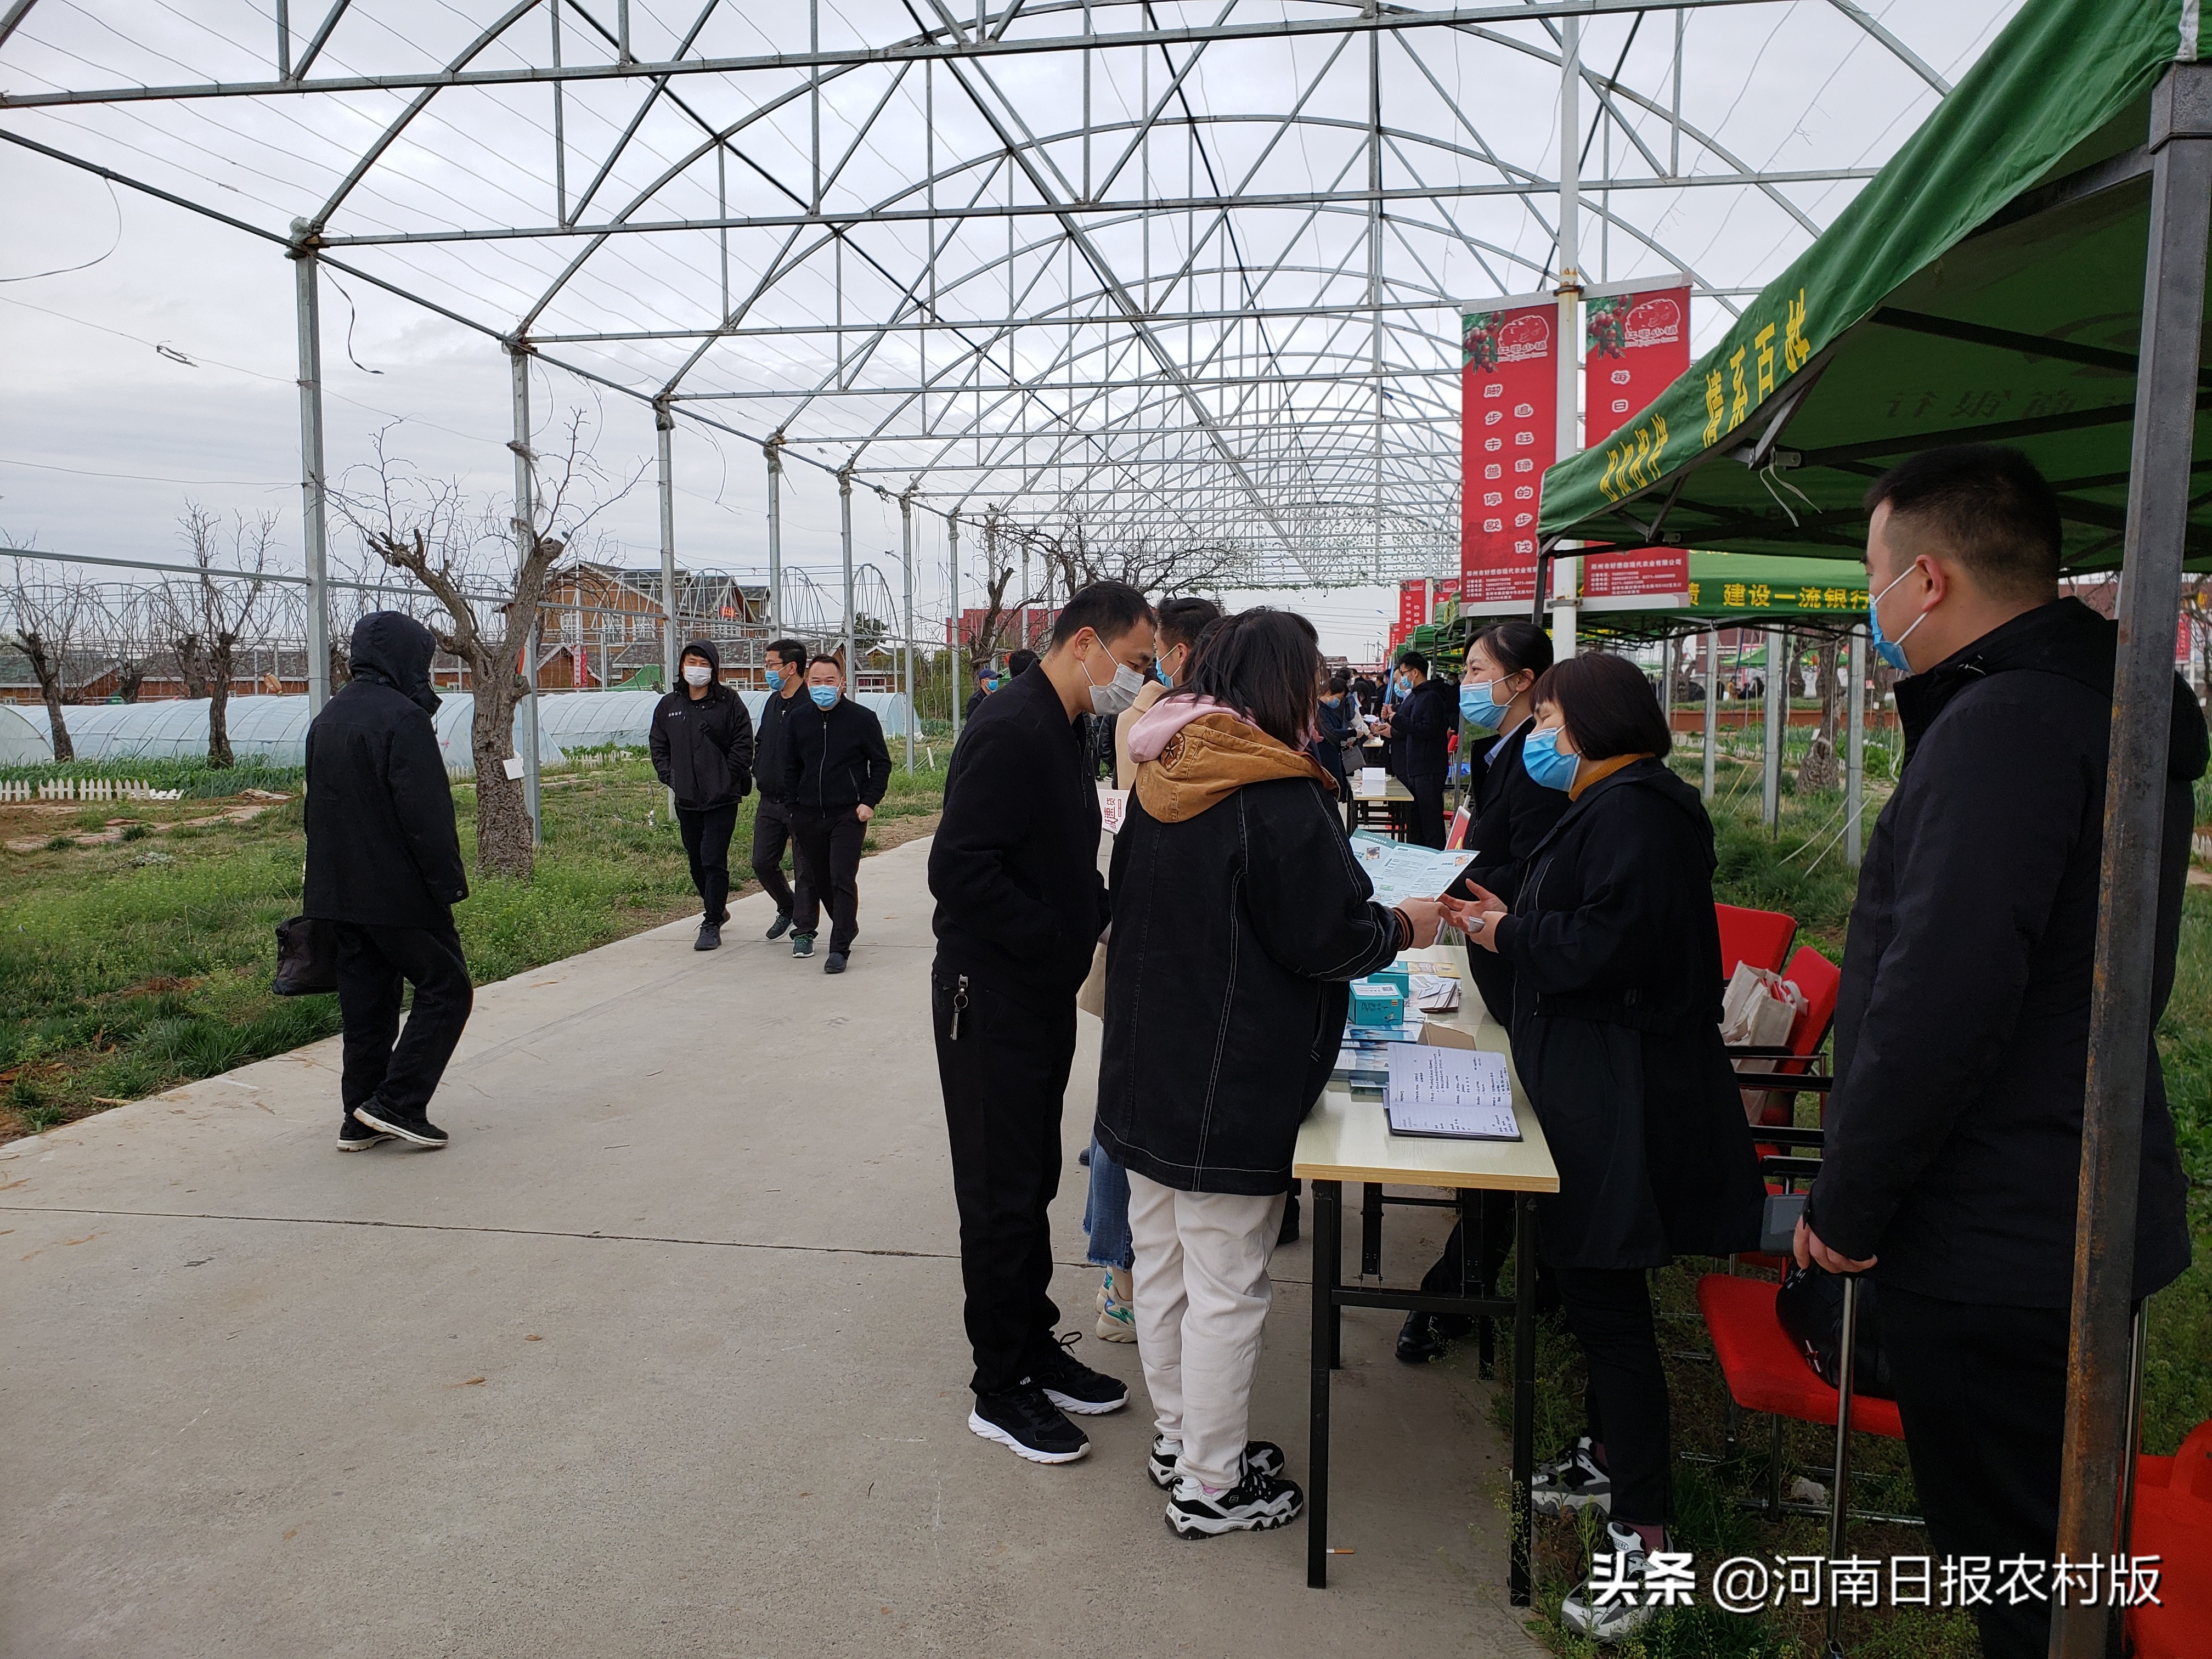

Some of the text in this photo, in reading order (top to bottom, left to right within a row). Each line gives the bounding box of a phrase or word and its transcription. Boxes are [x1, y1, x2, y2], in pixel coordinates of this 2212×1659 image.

[1610, 369, 1631, 435] 每日
[1703, 287, 1811, 448] 情系百姓
[1483, 384, 1503, 532] 脚步未曾停歇
[1514, 404, 1534, 554] 追赶绿的步伐
[1723, 583, 1869, 610] 建设一流银行
[1020, 1376, 1031, 1385] ANTA
